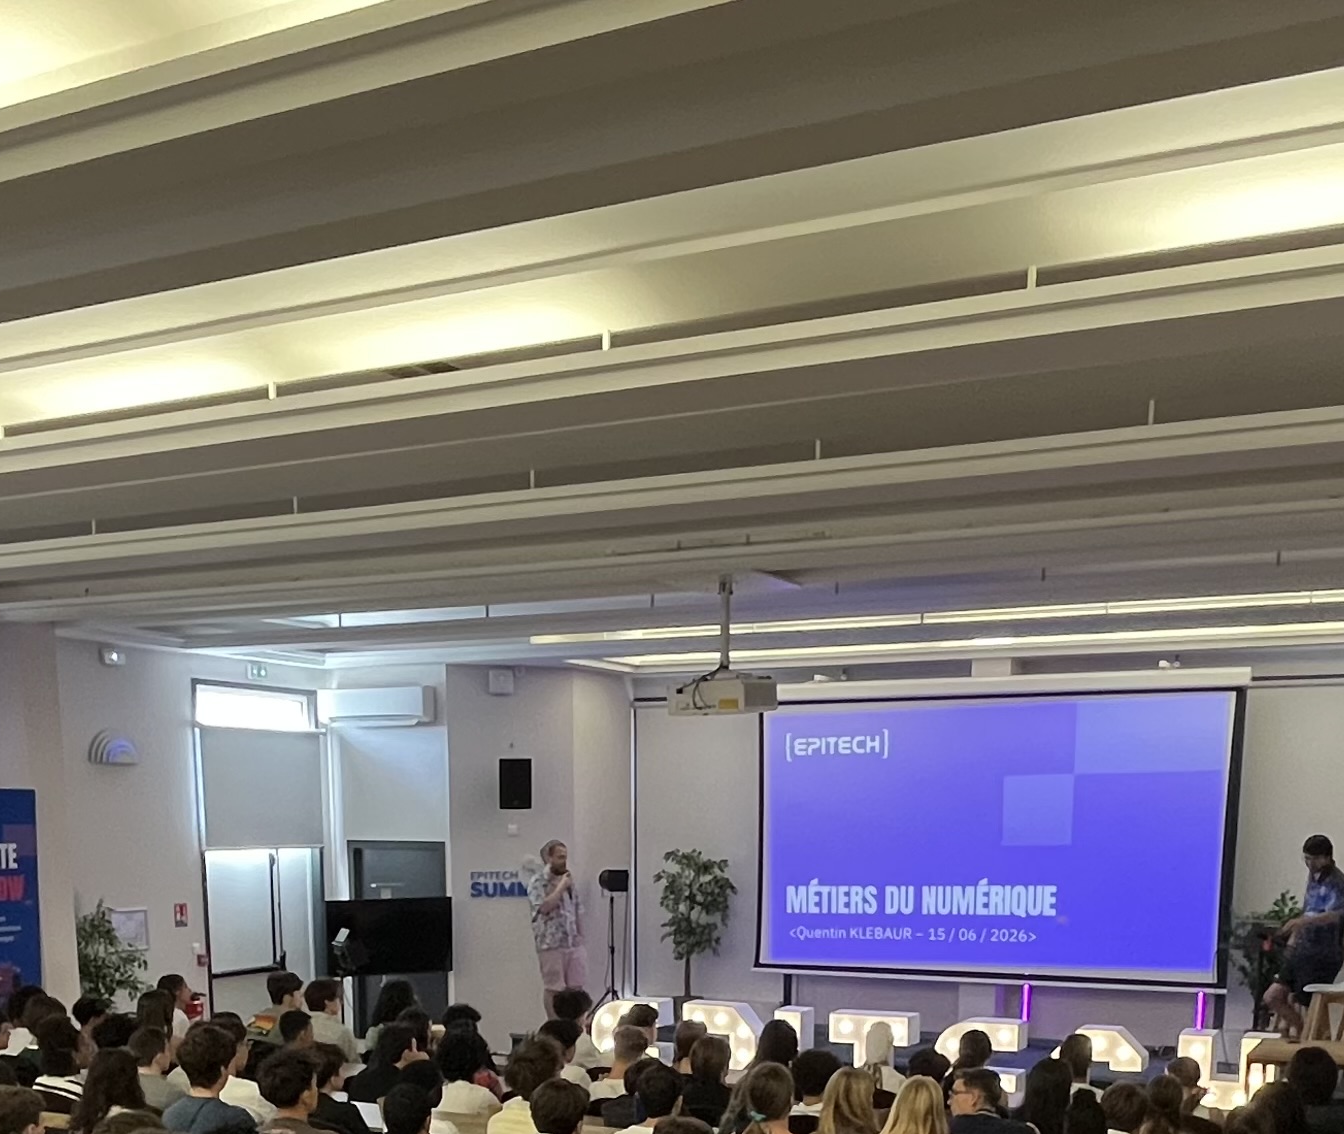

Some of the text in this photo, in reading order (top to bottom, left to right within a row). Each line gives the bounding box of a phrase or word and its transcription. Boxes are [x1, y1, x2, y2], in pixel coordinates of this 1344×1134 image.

[470, 881, 529, 898] SUMM
[786, 878, 1058, 917] MÉTIERS DU NUMÉRIQUE
[849, 926, 912, 940] KLEBAUR
[928, 927, 946, 941] 15
[958, 928, 977, 942] 06
